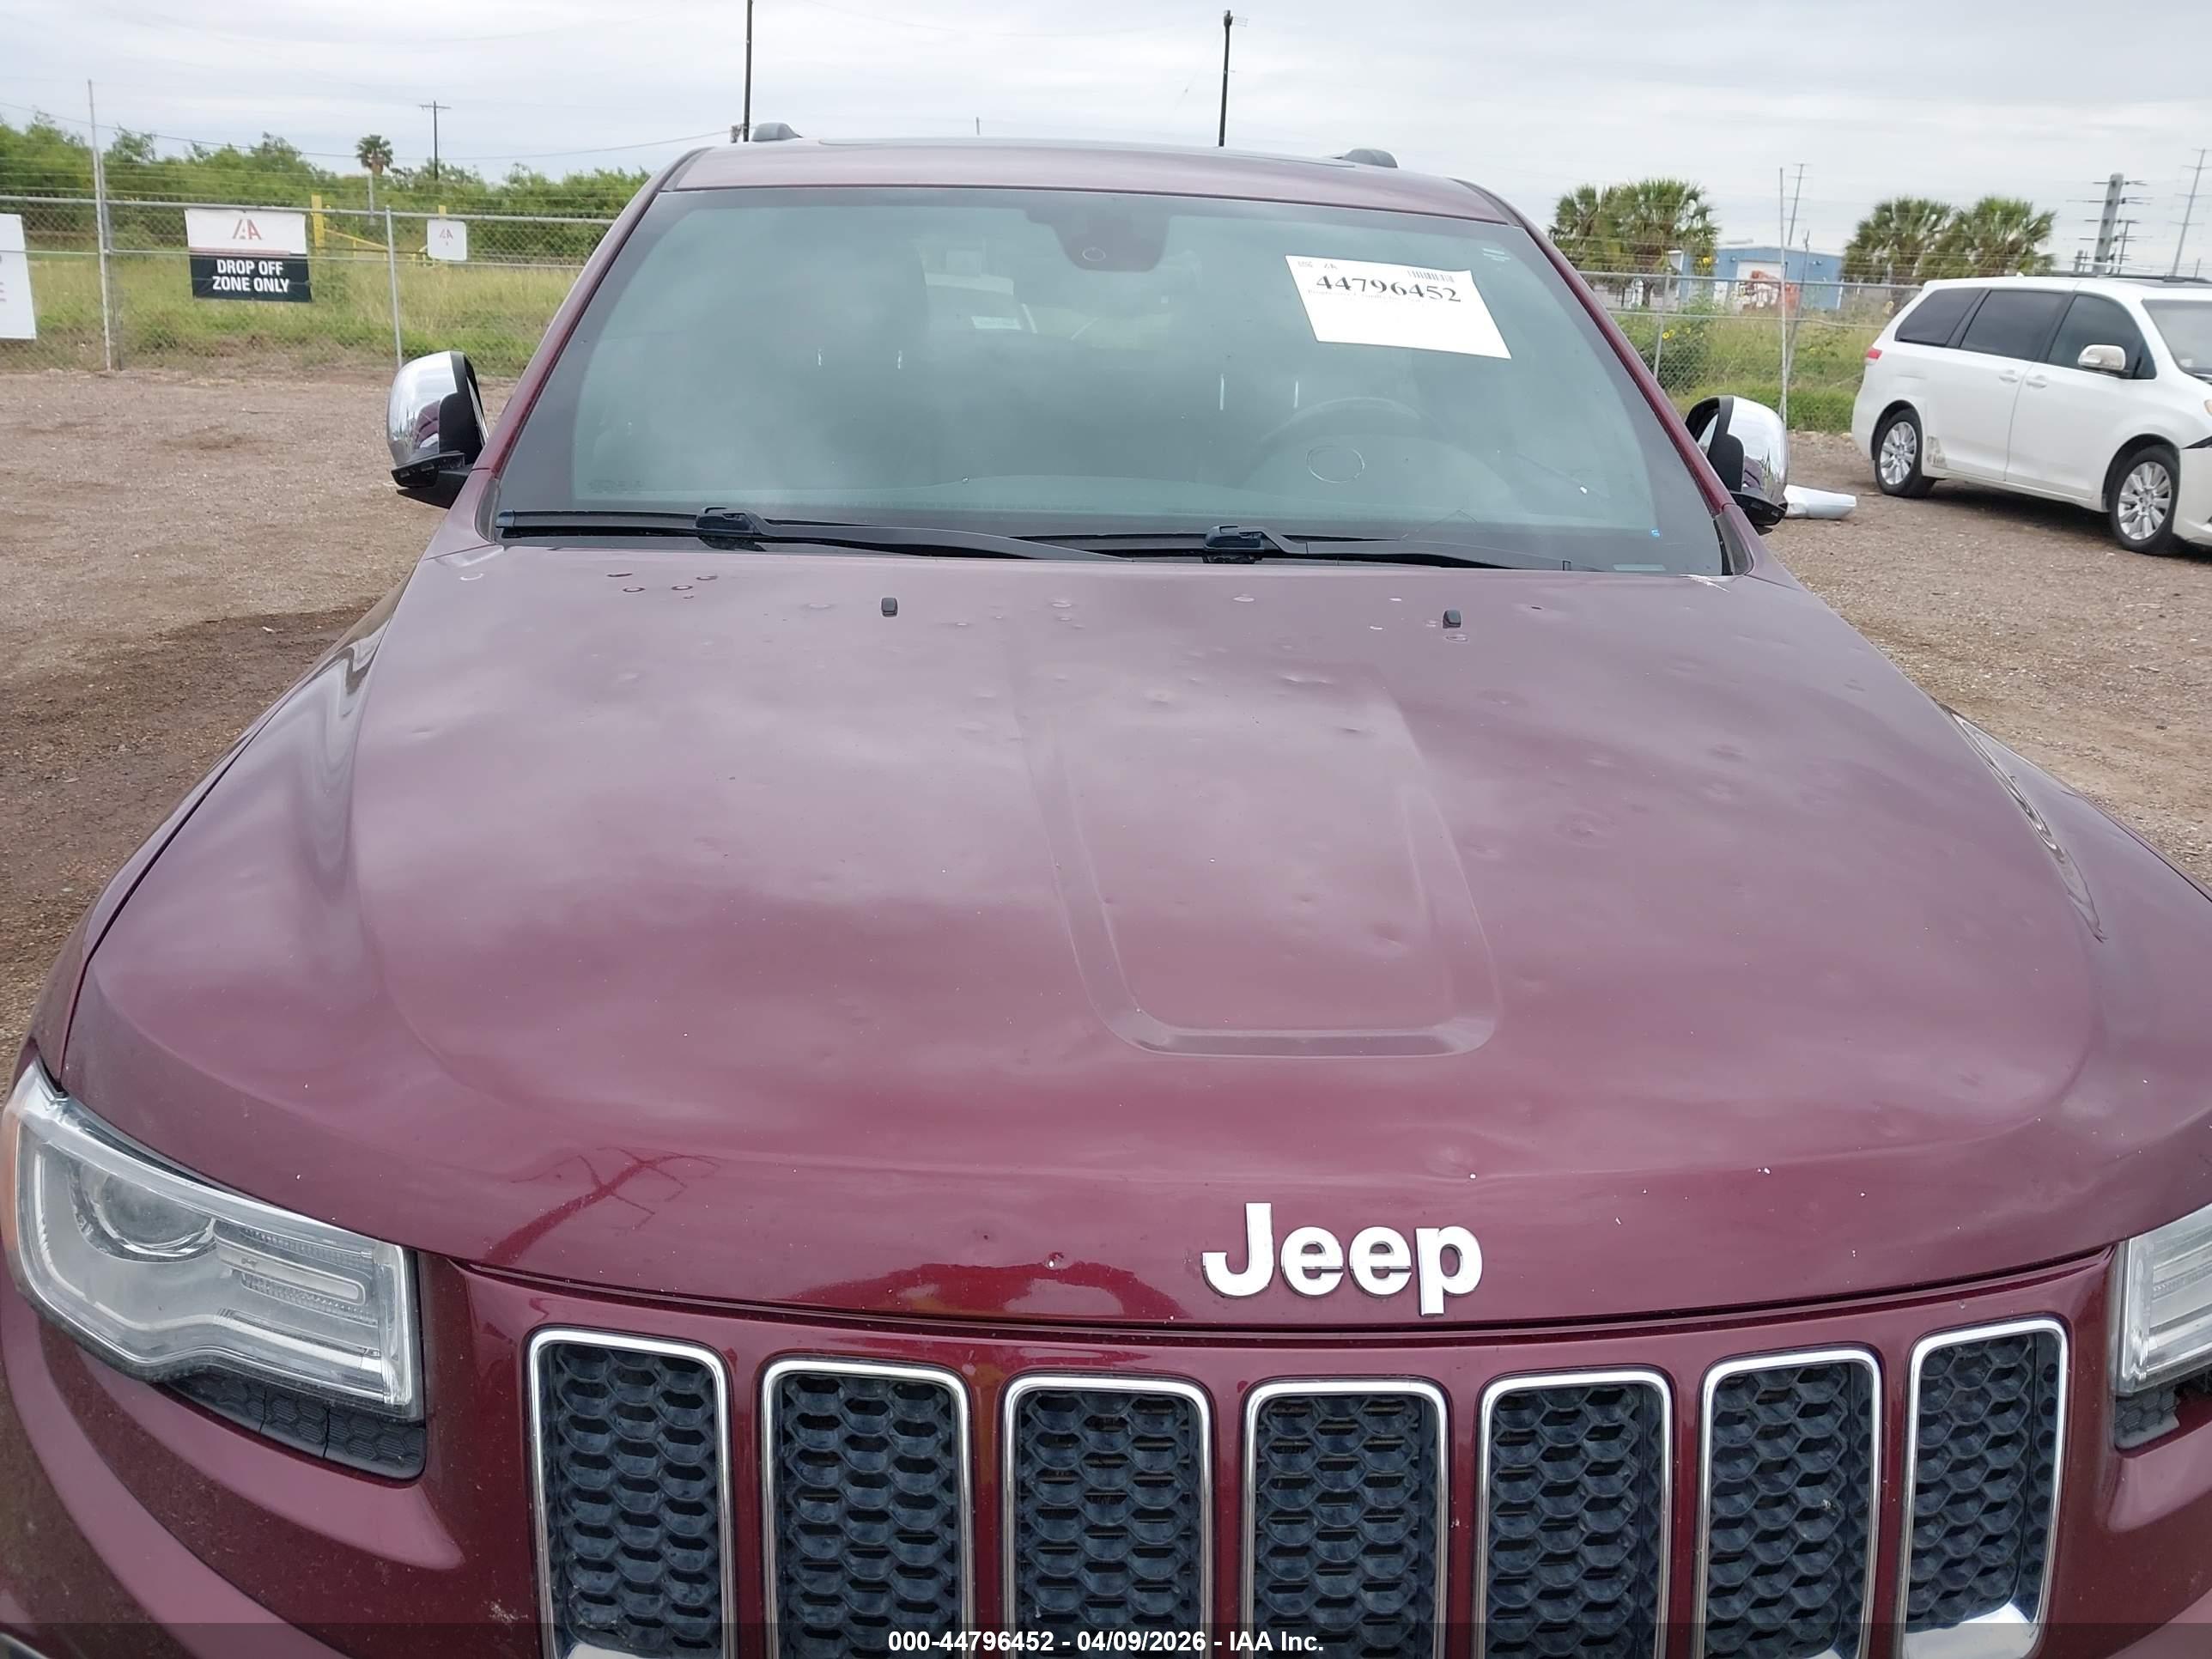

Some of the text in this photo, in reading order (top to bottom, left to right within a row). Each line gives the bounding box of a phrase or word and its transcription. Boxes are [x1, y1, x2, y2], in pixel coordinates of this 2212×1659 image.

[216, 259, 283, 276] DROP OFF
[212, 276, 289, 293] ZONE ONLY
[1316, 275, 1462, 302] 44796452
[1202, 1202, 1483, 1316] Jeep
